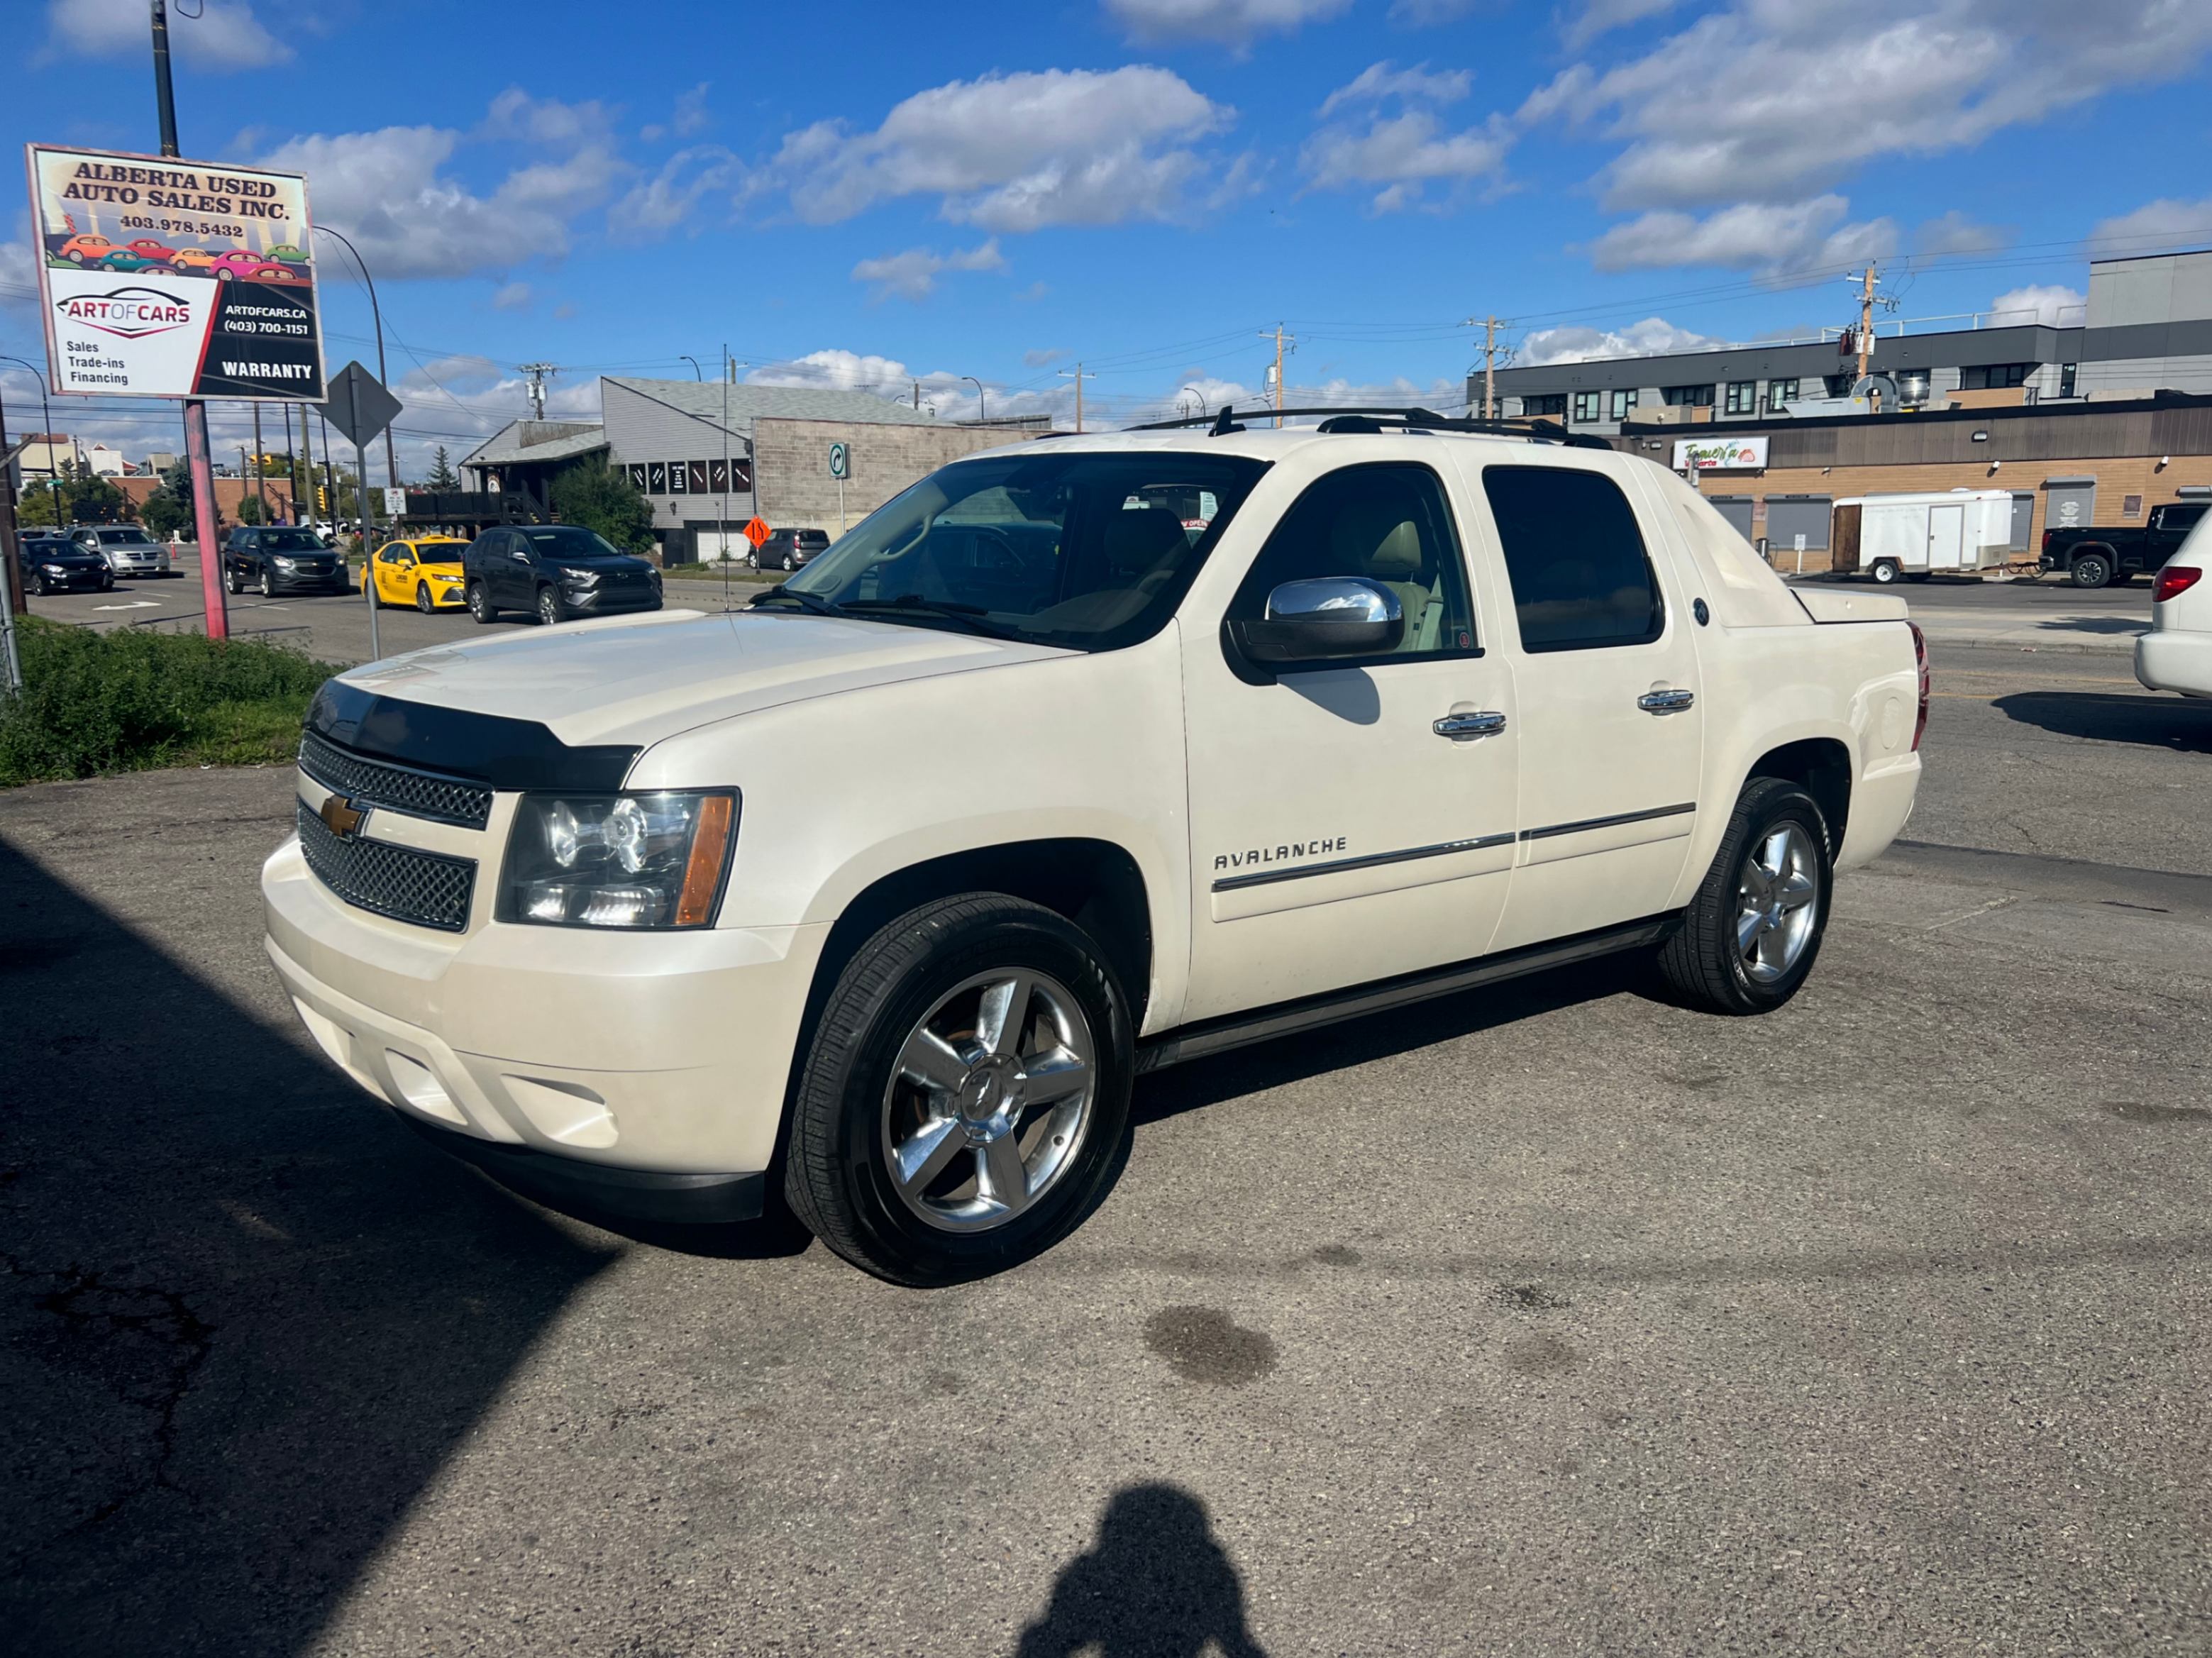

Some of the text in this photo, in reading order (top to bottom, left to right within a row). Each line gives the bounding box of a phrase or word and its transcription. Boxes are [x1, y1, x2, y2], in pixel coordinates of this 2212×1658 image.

[74, 162, 276, 198] ALBERTA USED
[63, 182, 290, 221] AUTO SALES INC.
[120, 216, 243, 238] 403.978.5432
[68, 302, 190, 323] ARTOFCARS
[225, 305, 306, 319] ARTOFCARS.CA
[224, 319, 308, 335] (403) 700-1151
[67, 341, 99, 353] Sales
[68, 356, 125, 368] Trade-ins
[221, 360, 311, 379] WARRANTY
[70, 372, 128, 385] Financing
[1214, 836, 1346, 870] AVALANCHE
